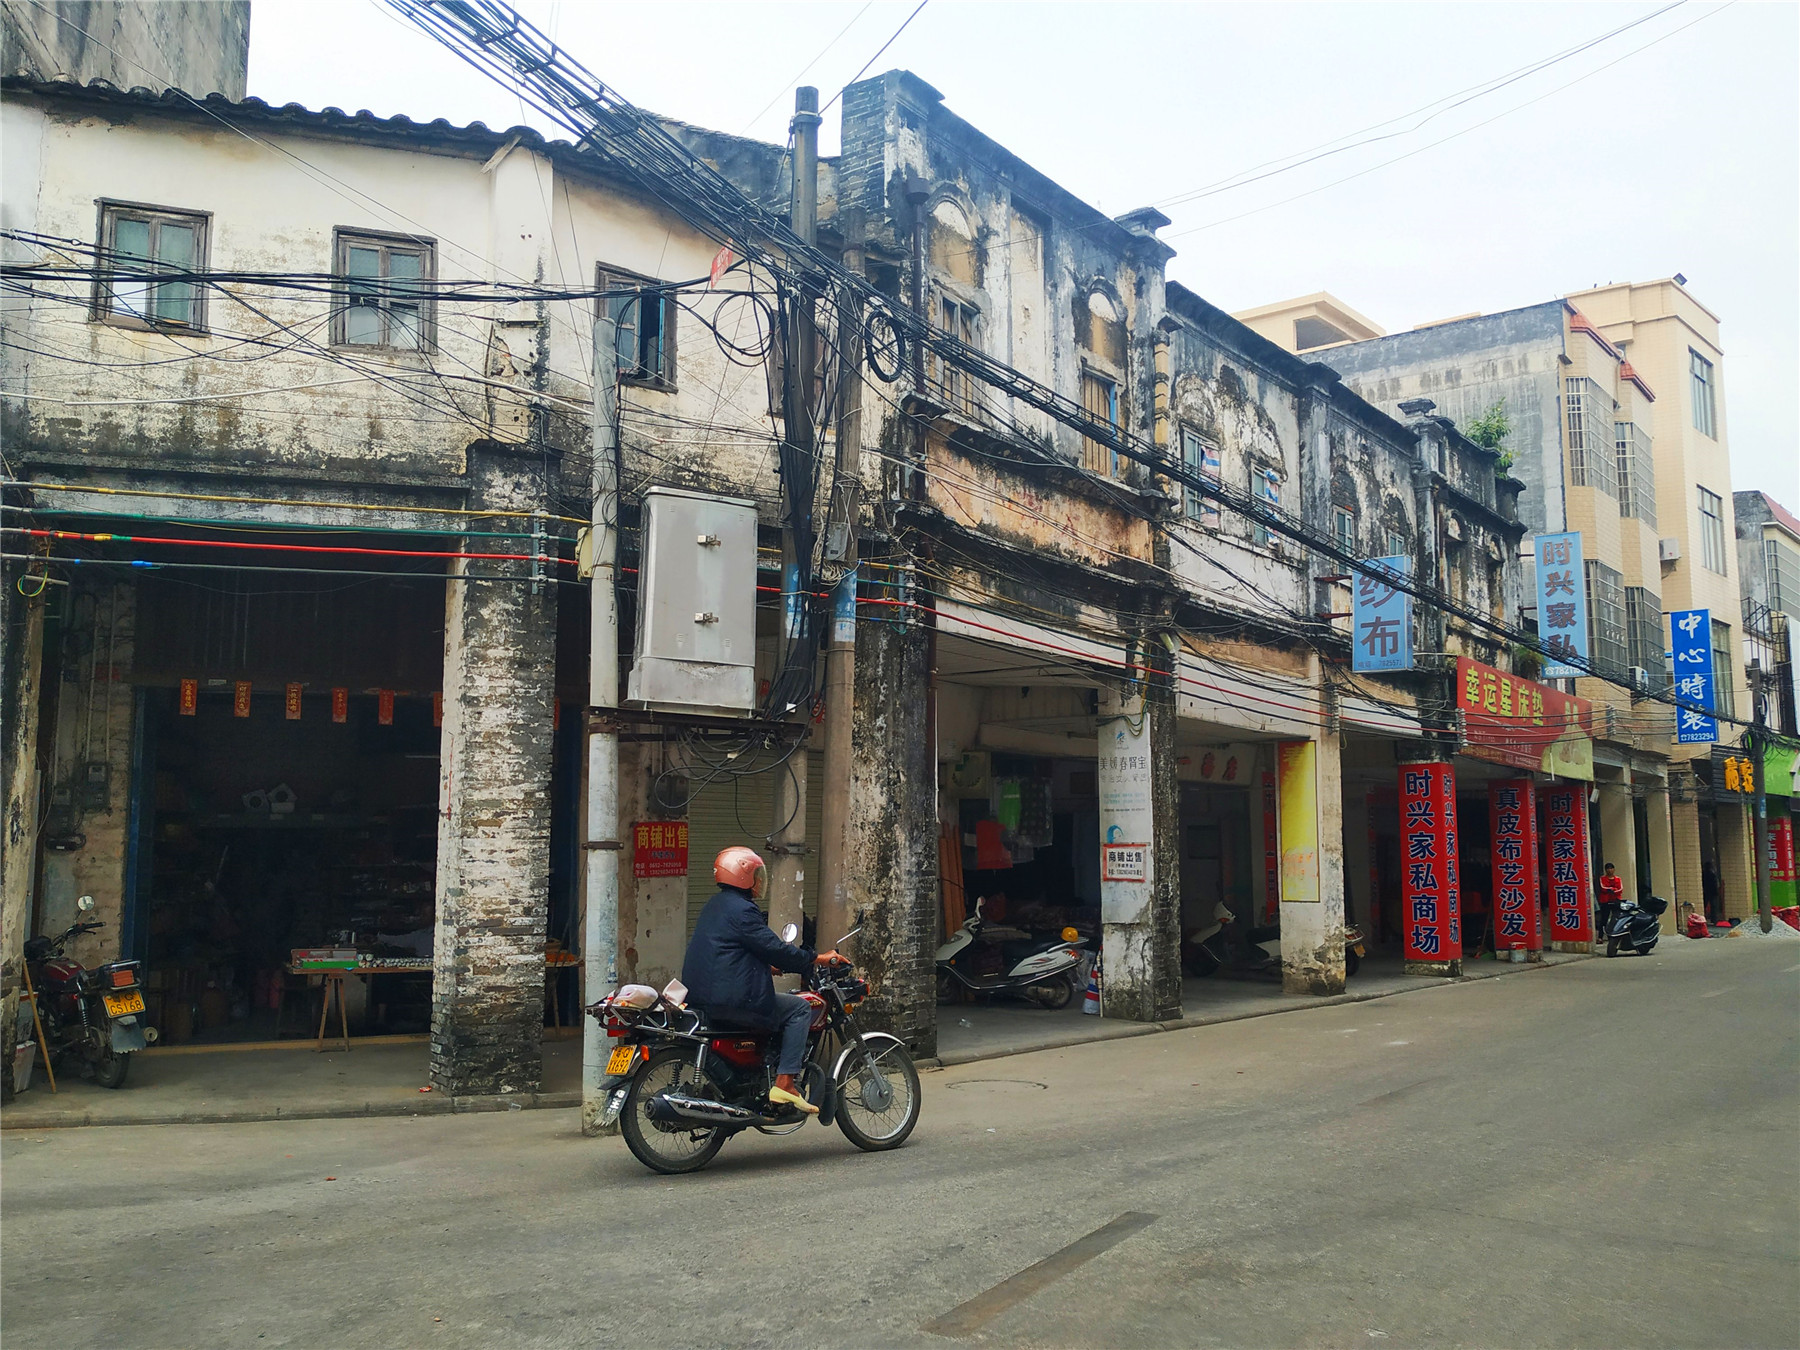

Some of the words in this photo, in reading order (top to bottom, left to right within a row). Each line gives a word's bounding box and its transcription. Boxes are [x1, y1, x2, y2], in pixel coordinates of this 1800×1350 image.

[1466, 666, 1544, 726] 幸运星床垫
[637, 825, 688, 849] 商铺出售
[1109, 851, 1142, 863] 商铺出售
[1405, 770, 1440, 954] 时兴家私商场
[1443, 774, 1459, 944] 时兴家私商场
[1496, 787, 1528, 937] 真皮布艺沙发
[1551, 792, 1581, 930] 时兴家私商场
[110, 1000, 142, 1014] CS168
